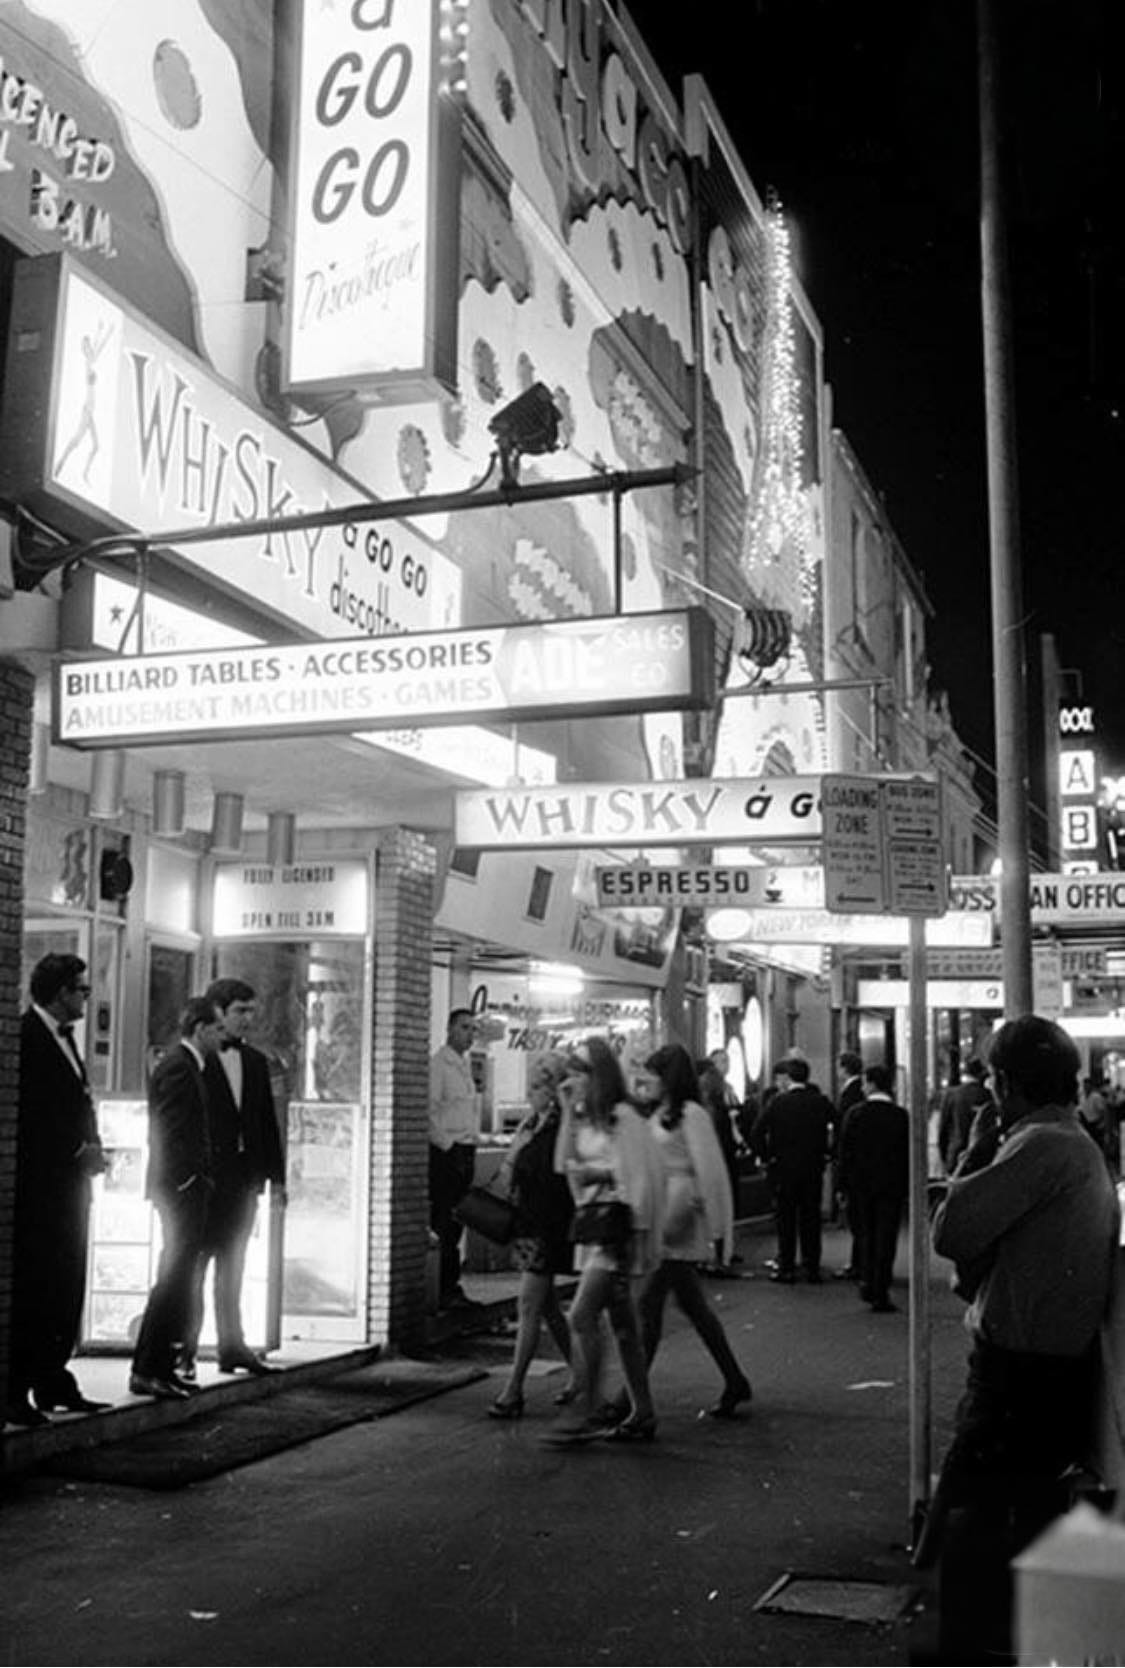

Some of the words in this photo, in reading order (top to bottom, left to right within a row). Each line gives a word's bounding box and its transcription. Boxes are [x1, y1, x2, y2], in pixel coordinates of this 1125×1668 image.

[315, 42, 413, 128] GO
[0, 75, 115, 182] CENCED
[311, 138, 411, 225] GO
[131, 352, 330, 596] WHISKY
[365, 528, 393, 574] GO
[401, 554, 428, 598] GO
[329, 554, 409, 635] discoth
[612, 624, 685, 651] SALES
[66, 666, 178, 696] BILLIARD
[187, 658, 281, 686] TABLES
[303, 641, 492, 678] ACCESSORIES
[65, 696, 222, 730] AMUSEMENT
[231, 685, 373, 718] MACHINES
[395, 677, 493, 706] GAMES
[485, 786, 723, 837] WHISKY
[791, 793, 823, 819] G
[826, 786, 878, 809] LOADING
[835, 813, 869, 835] ZONE
[601, 870, 751, 895] ESPRESSO
[950, 885, 997, 910] OSS
[242, 912, 272, 928] OPEN
